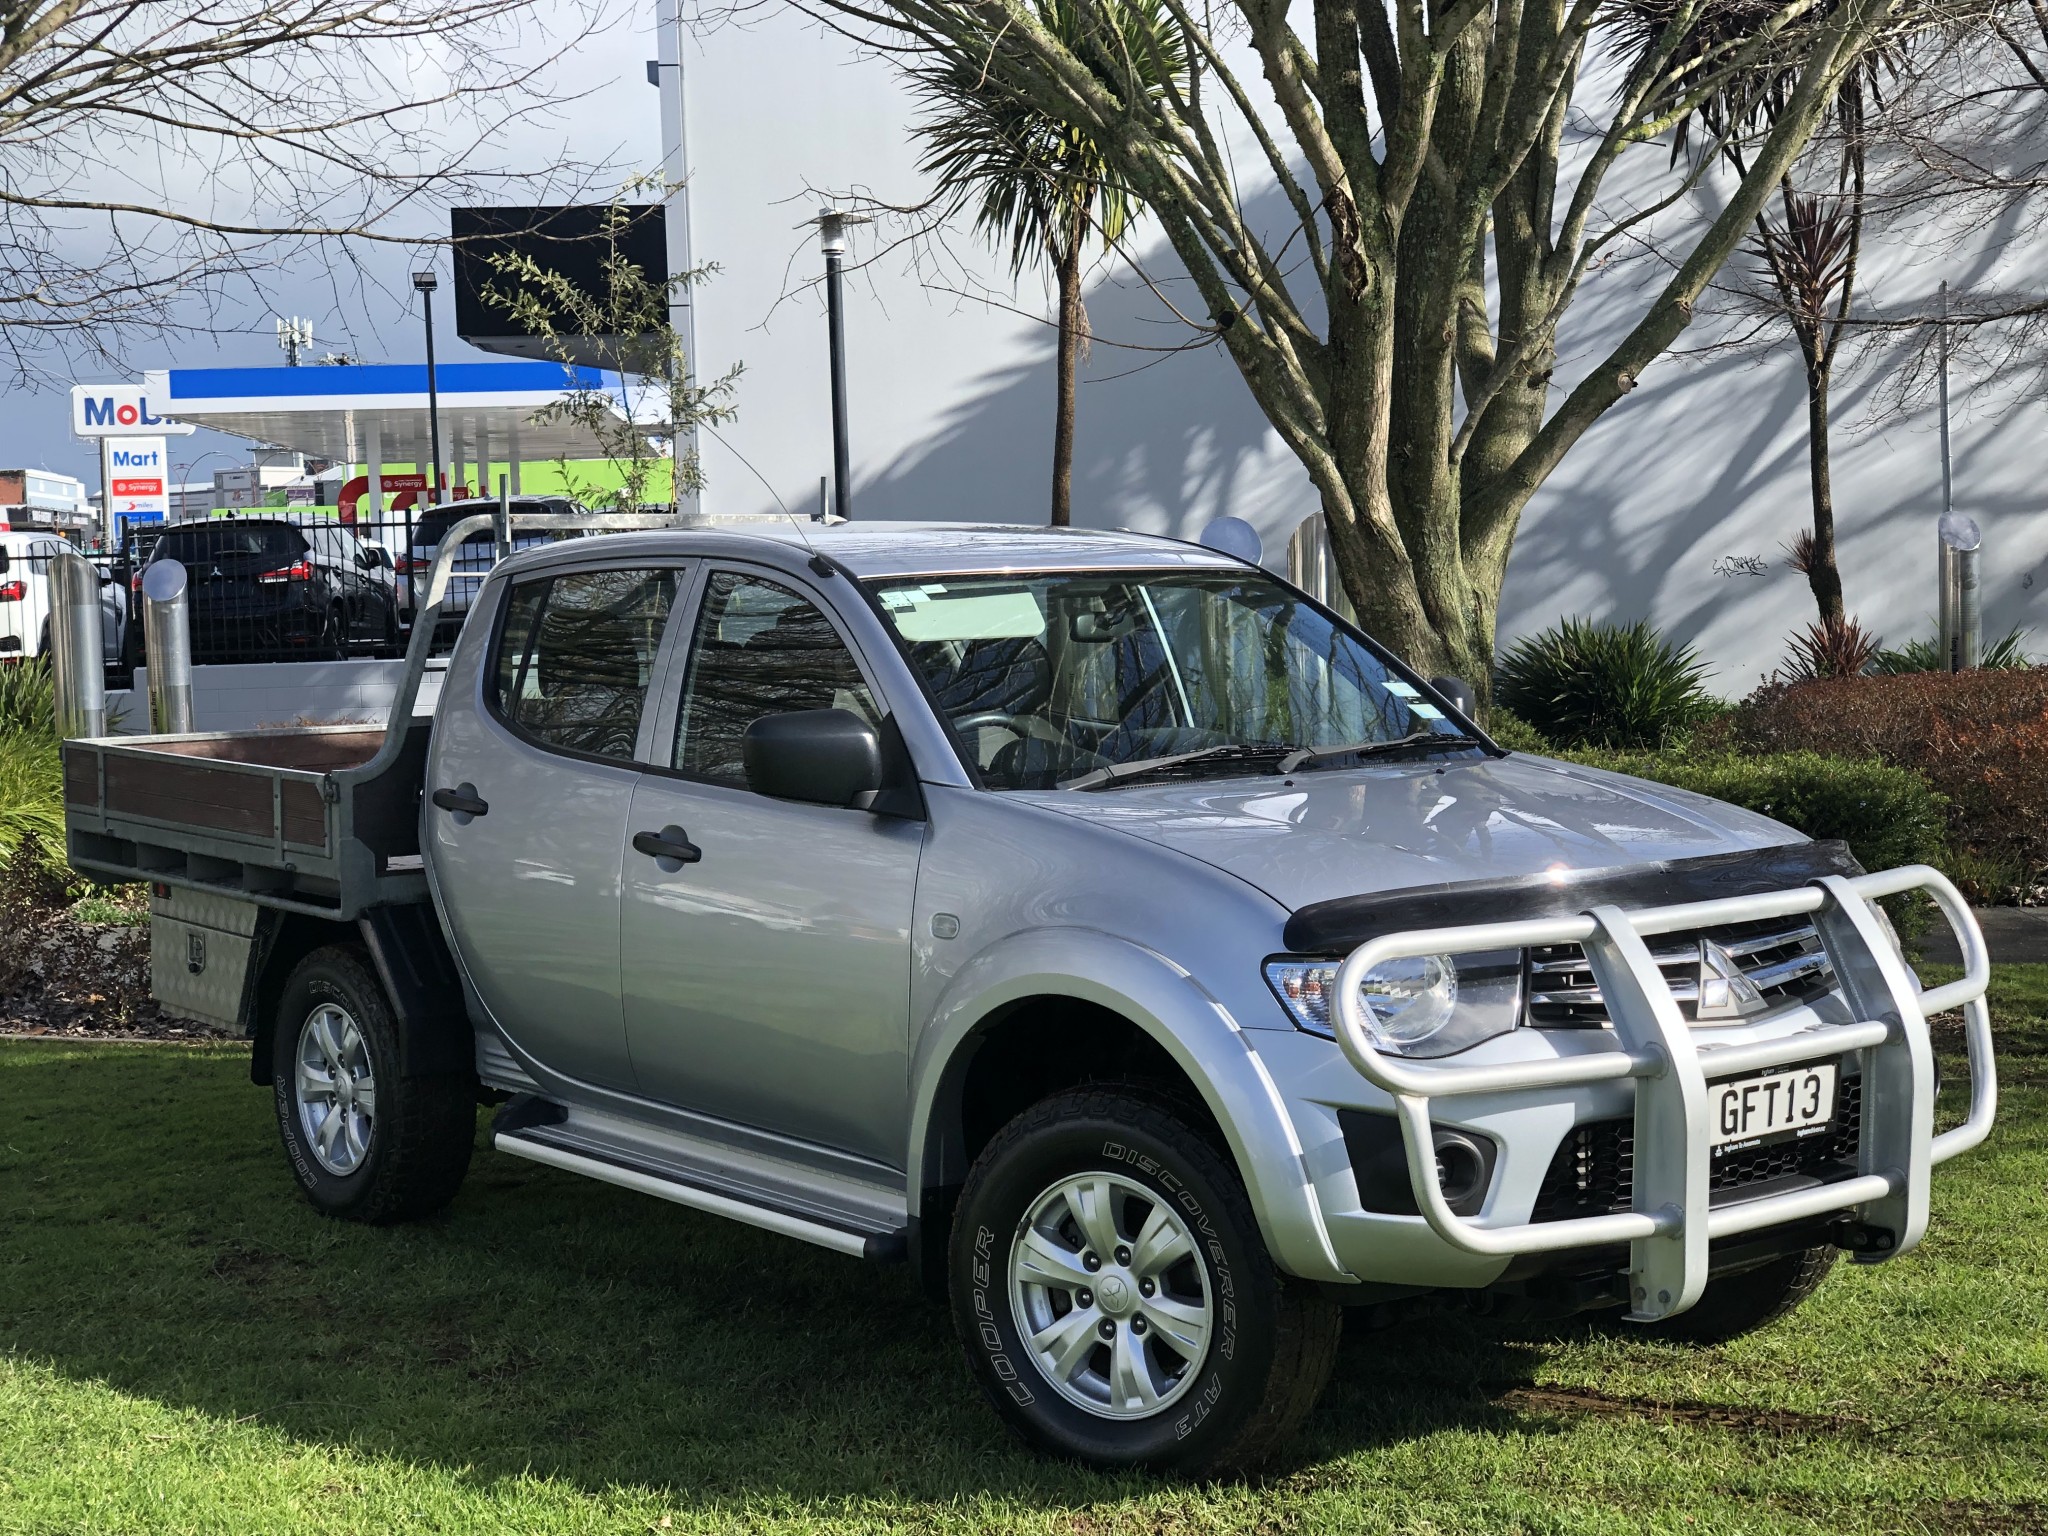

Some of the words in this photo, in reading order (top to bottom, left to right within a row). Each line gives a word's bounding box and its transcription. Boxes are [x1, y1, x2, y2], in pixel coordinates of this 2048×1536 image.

[84, 397, 181, 426] Mob
[113, 451, 158, 467] Mart
[128, 483, 158, 492] Synergy
[394, 480, 422, 488] Synergy
[1720, 1074, 1821, 1136] GFT13
[276, 1075, 318, 1189] COOPER
[1102, 1141, 1237, 1360] DISCOVERER
[1173, 1372, 1222, 1440] AT3
[973, 1226, 1036, 1407] COOPER
